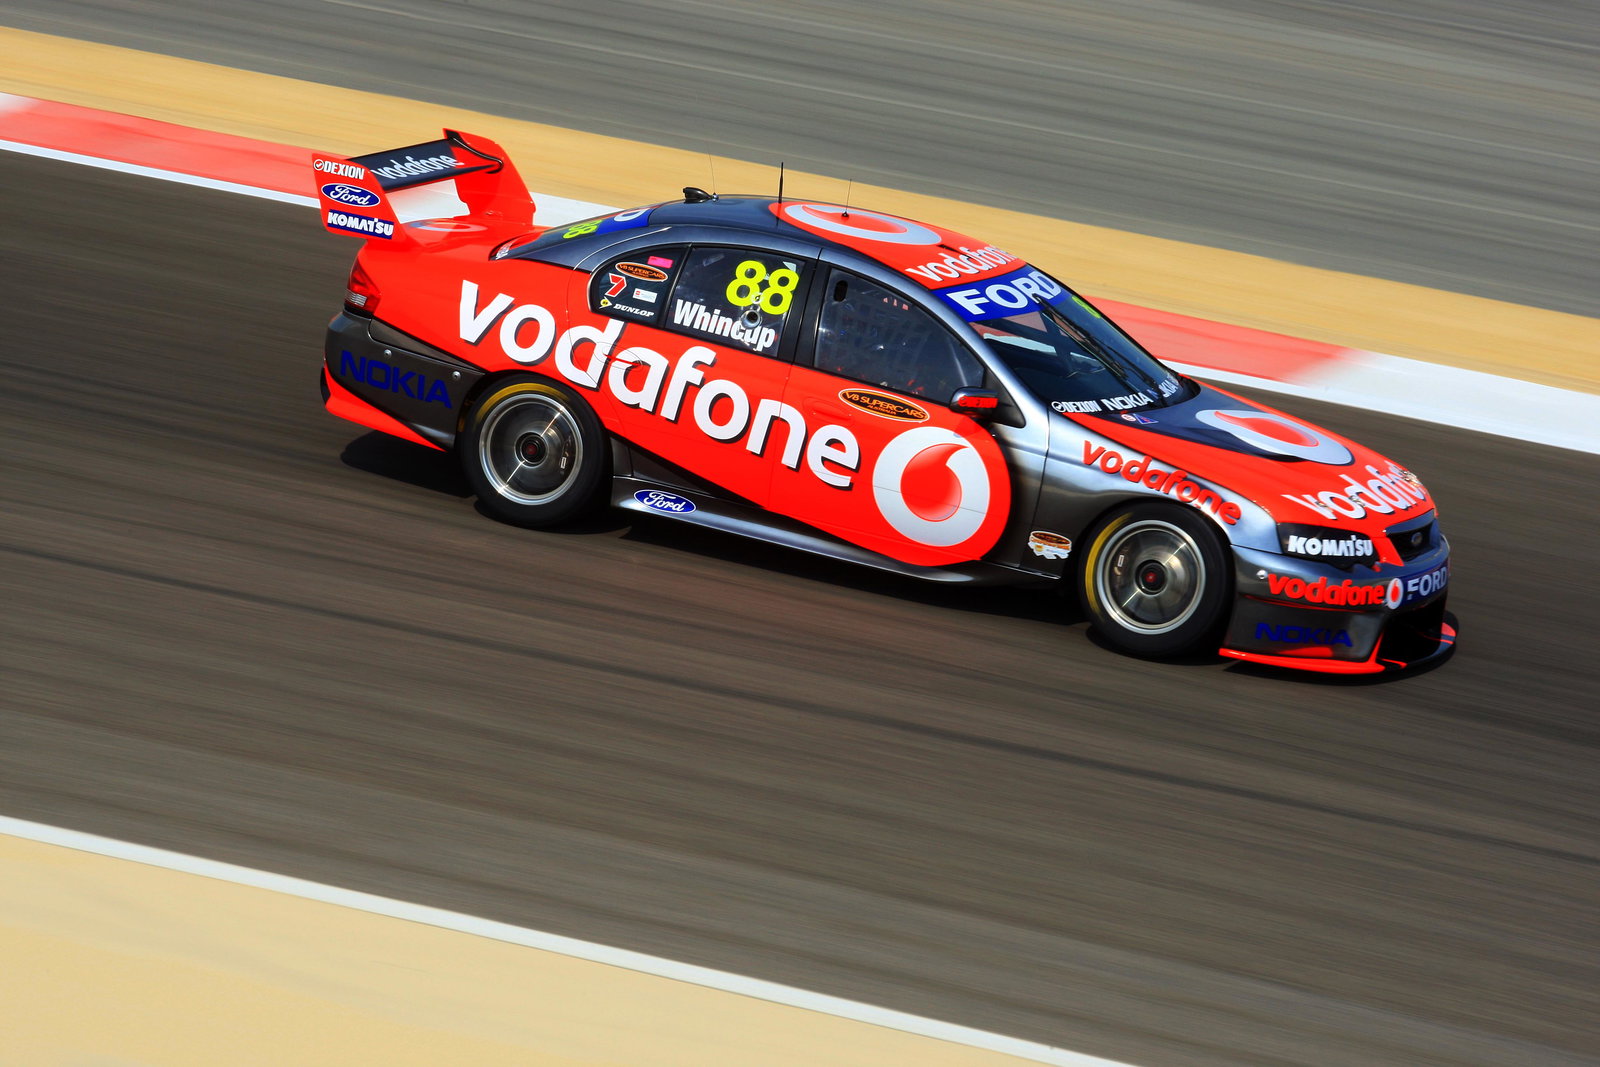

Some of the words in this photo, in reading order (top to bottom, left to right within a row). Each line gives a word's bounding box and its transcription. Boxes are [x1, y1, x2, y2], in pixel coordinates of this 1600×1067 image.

[323, 160, 365, 180] DEXION
[370, 156, 465, 179] vodafone
[330, 184, 371, 206] Ford
[327, 211, 394, 237] KOMATSU
[726, 260, 800, 315] 88
[946, 270, 1062, 316] FORD
[613, 303, 655, 317] DUNLOP
[673, 298, 776, 352] Whincup
[340, 350, 453, 409] NOKIA
[459, 279, 862, 491] vodafone
[845, 391, 860, 401] V8
[860, 396, 926, 419] SUPERCARS
[1101, 391, 1154, 411] NOKIA
[1082, 440, 1242, 526] vodafone
[643, 491, 685, 512] Ford
[1287, 535, 1374, 557] KOMATSU
[1267, 573, 1385, 606] vodafone
[1407, 566, 1448, 600] FORD
[1254, 622, 1353, 647] NOKIA
